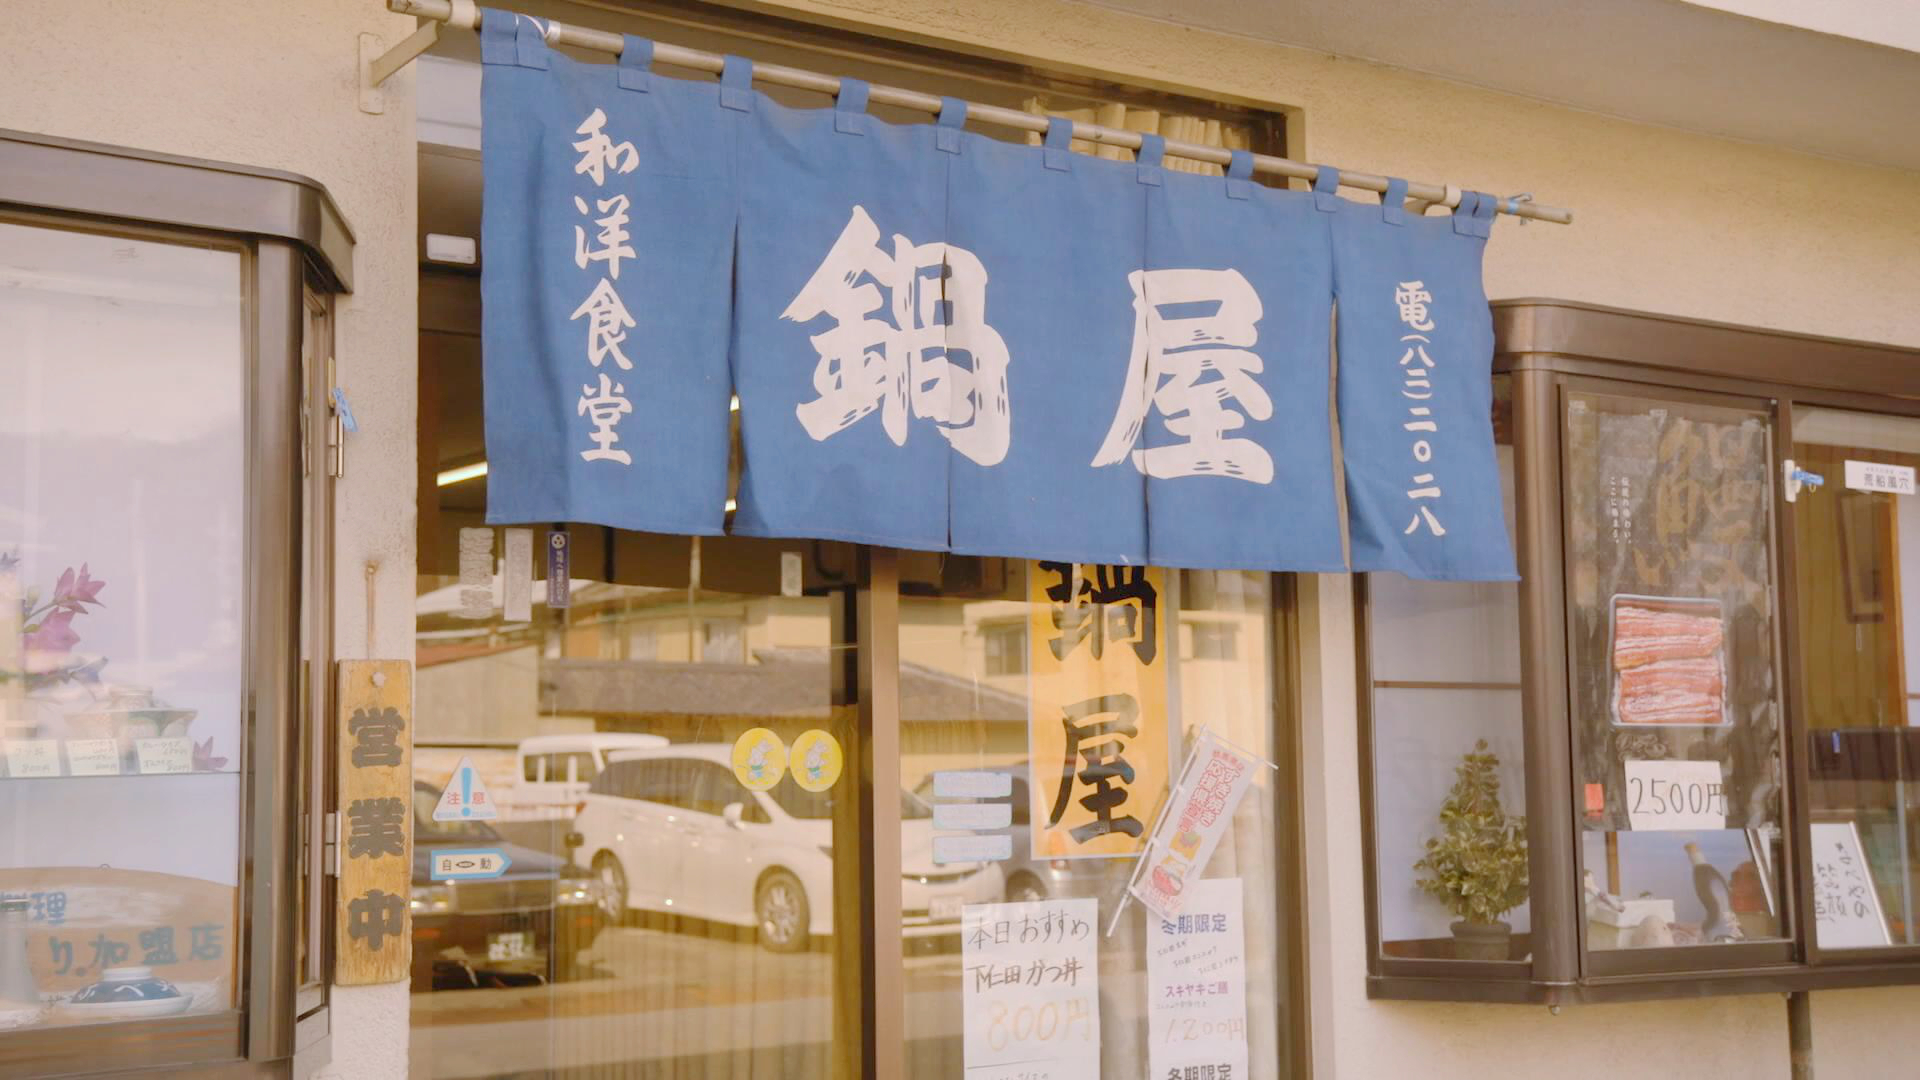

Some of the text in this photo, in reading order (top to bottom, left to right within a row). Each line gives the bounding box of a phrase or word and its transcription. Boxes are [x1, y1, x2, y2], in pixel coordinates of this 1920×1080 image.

[570, 108, 640, 466] 和洋食堂
[779, 205, 1275, 485] 鍋屋
[347, 706, 406, 951] 営業中
[1038, 560, 1158, 845] 鍋屋
[1629, 777, 1724, 816] 2500円
[986, 996, 1091, 1052] 800円
